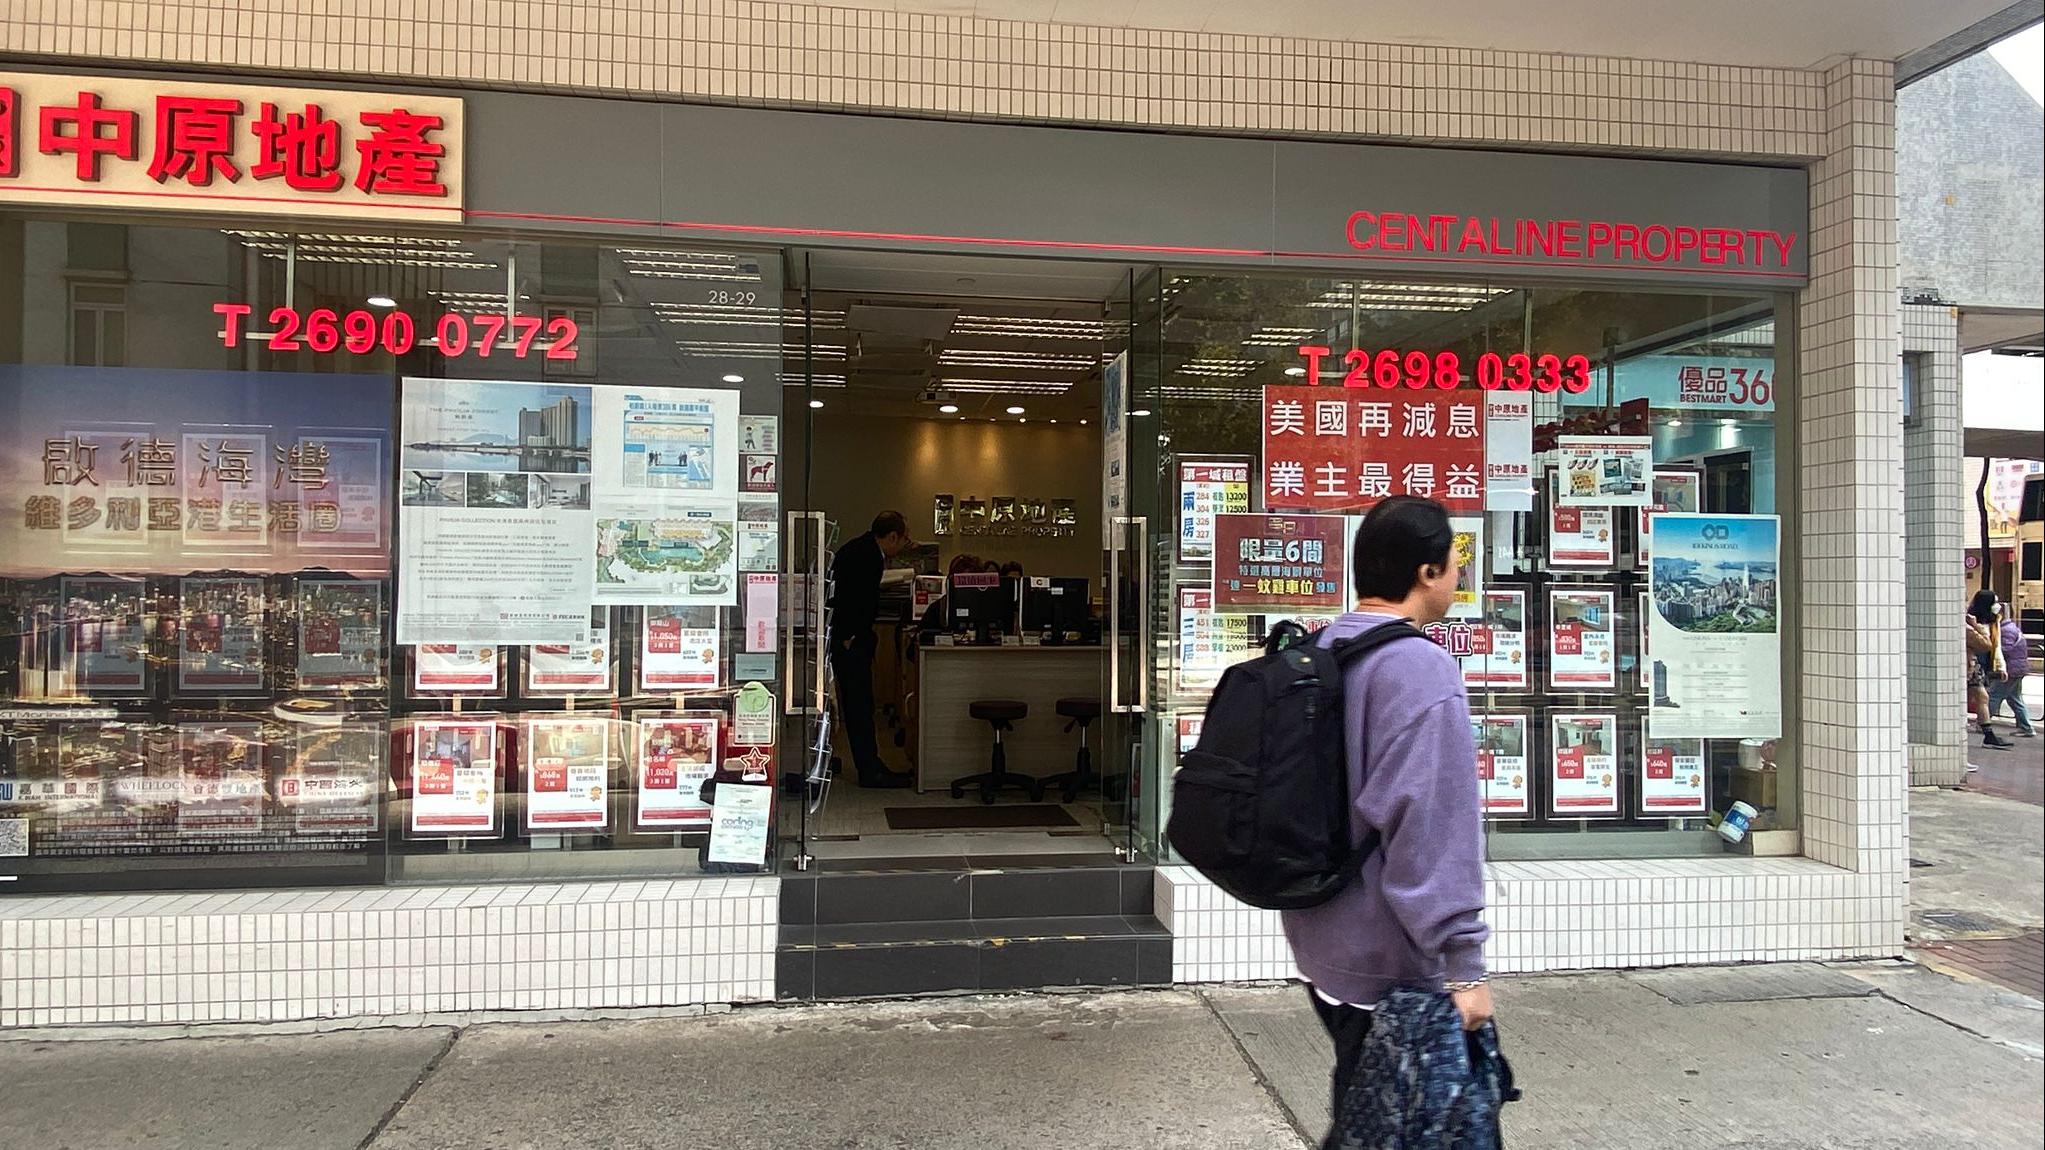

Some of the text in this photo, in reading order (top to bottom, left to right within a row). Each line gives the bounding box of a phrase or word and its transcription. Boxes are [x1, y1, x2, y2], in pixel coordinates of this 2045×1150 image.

[39, 90, 448, 197] 中原地產
[1346, 210, 1796, 267] CENTALINE PROPERTY
[708, 290, 756, 305] 28-29
[213, 303, 577, 360] T 2690 0772
[1299, 346, 1591, 393] T 2698 0333
[1678, 366, 1775, 405] 優品 36
[1680, 393, 1727, 404] BESTMART
[1269, 400, 1479, 438] 美國再減息
[1269, 461, 1479, 498] 業主最得益
[1226, 492, 1247, 501] 13200
[1226, 505, 1247, 513] 12500
[25, 496, 342, 532] 維多利亞港生活圈
[1240, 538, 1323, 564] 限量6間
[1183, 594, 1211, 607] 第一
[1226, 618, 1247, 627] 17500
[120, 781, 187, 792] WHEELOCK
